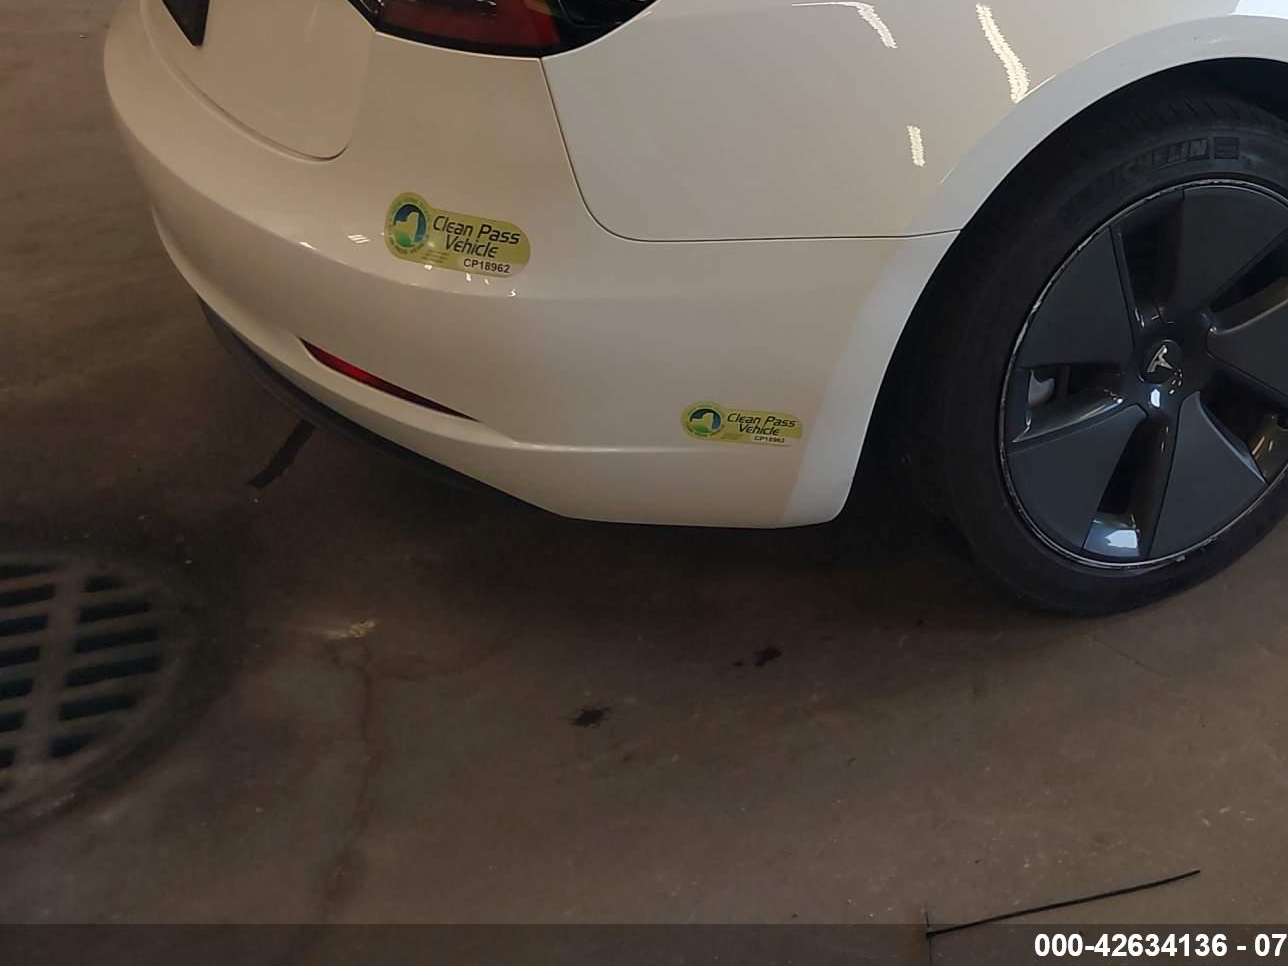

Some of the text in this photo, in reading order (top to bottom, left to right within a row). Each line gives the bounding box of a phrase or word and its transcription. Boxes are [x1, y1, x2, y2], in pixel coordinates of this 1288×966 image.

[433, 215, 521, 245] Clean Pass
[445, 234, 499, 258] Vehicle
[463, 258, 511, 274] CP18962
[727, 413, 797, 428] Clean Pass
[739, 423, 781, 436] Vehicle
